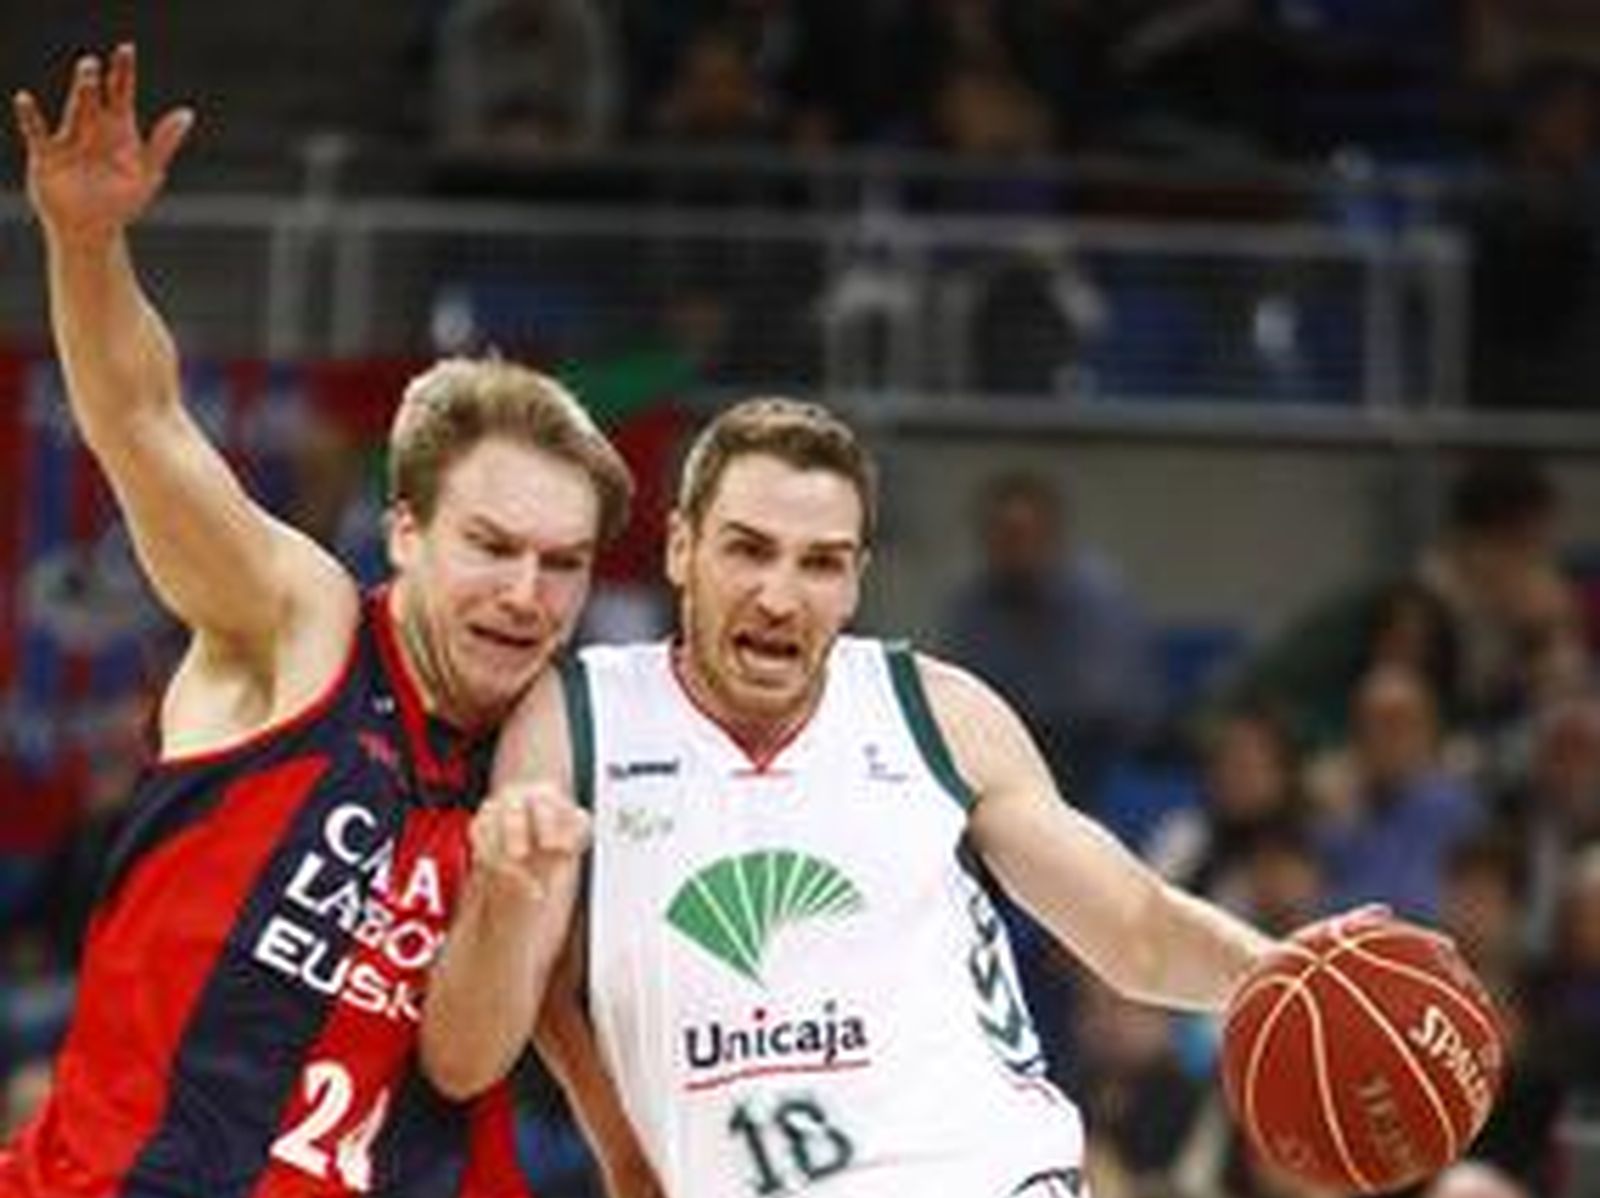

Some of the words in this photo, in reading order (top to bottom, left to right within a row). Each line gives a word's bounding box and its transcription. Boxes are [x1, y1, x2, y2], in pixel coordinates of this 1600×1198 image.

[286, 853, 448, 968] LABO
[324, 804, 446, 915] CAA
[684, 1001, 869, 1071] Unicaja
